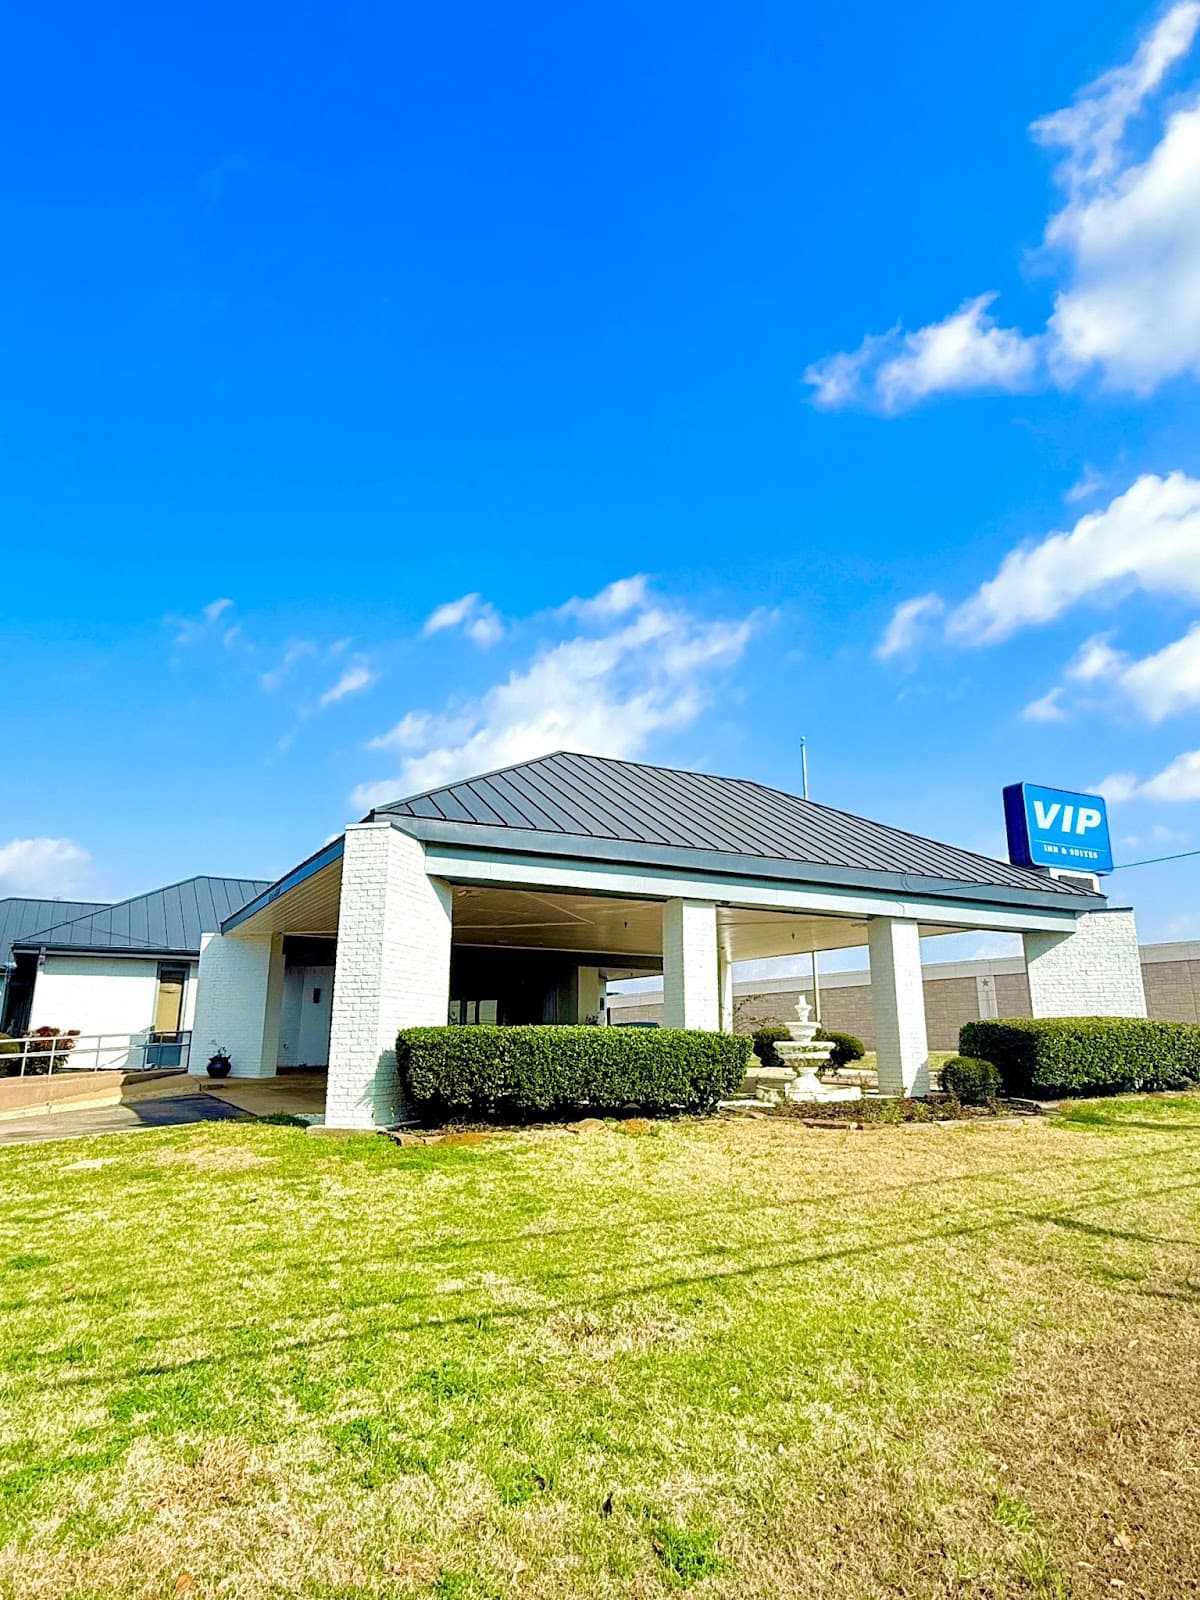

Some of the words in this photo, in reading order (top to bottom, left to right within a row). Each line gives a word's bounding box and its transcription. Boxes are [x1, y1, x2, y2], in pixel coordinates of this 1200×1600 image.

[1033, 800, 1102, 835] VIP
[1043, 844, 1059, 853] INN
[1061, 846, 1068, 855] &
[1070, 848, 1099, 859] SUITES
